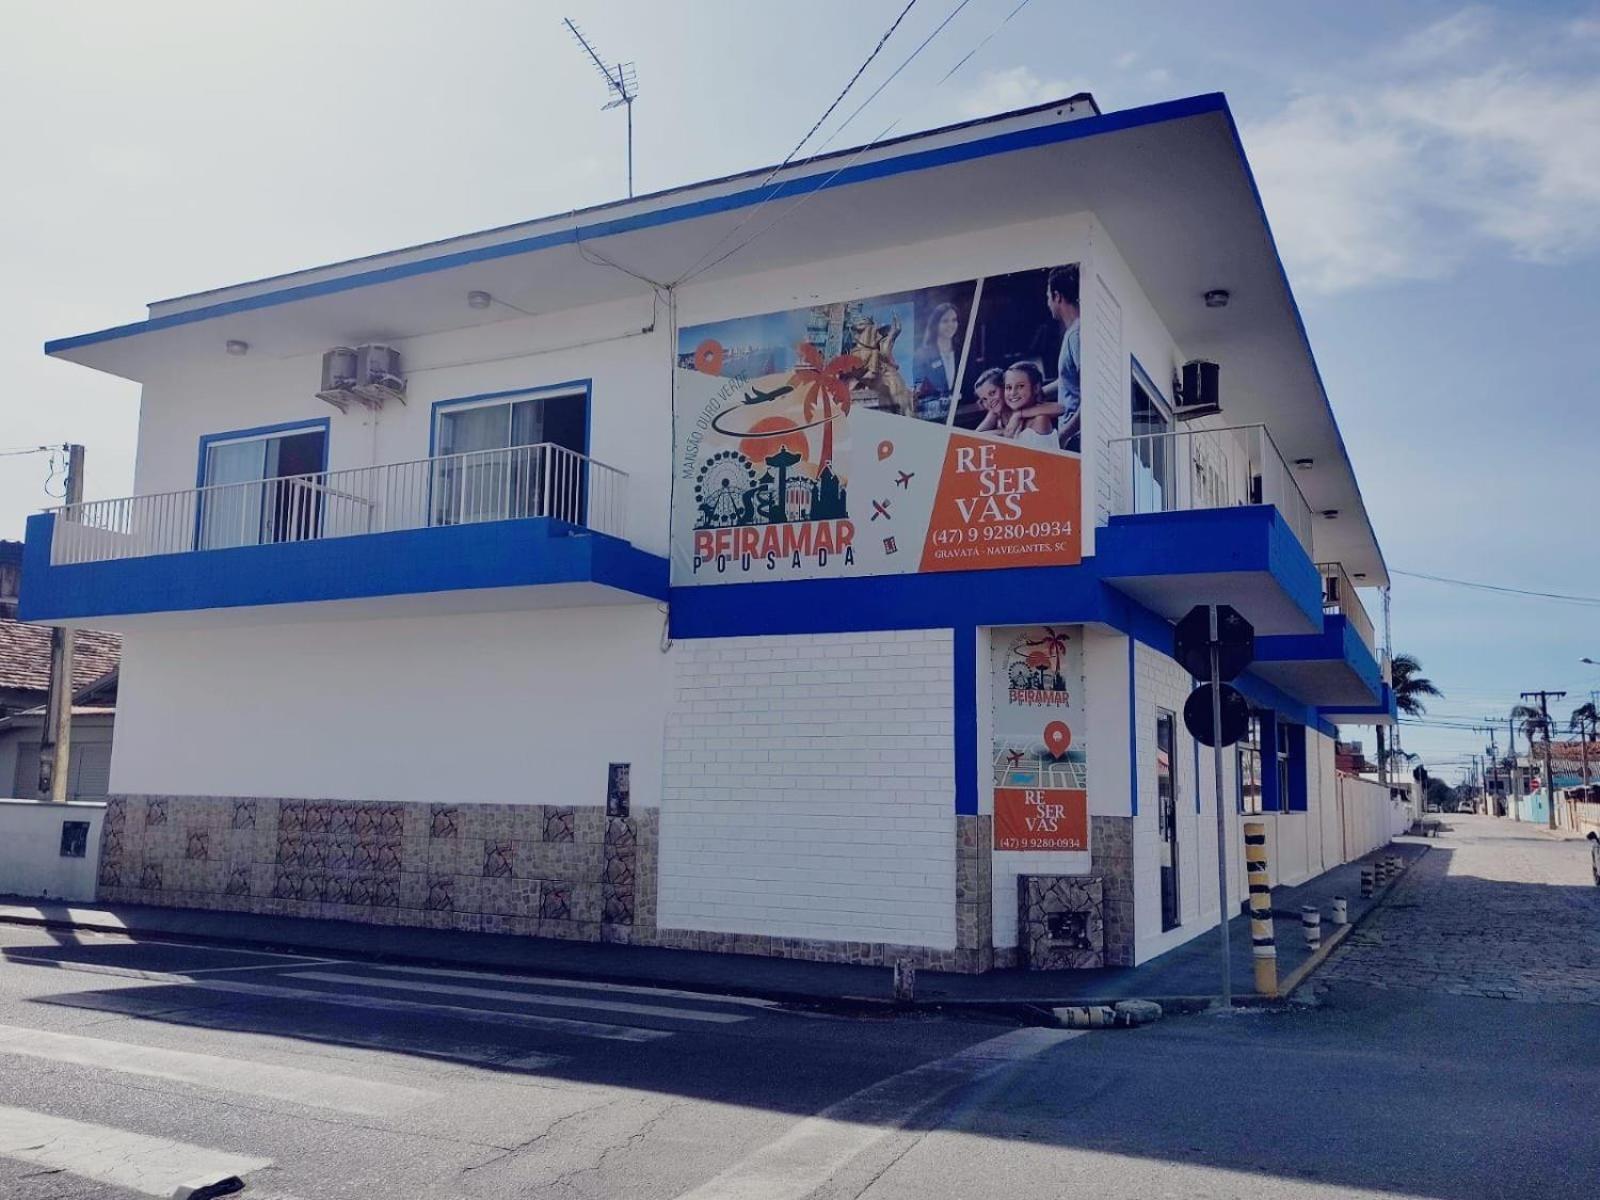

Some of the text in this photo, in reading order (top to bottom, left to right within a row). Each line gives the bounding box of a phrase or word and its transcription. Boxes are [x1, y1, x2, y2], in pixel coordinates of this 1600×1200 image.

[696, 398, 721, 431] OURO
[955, 444, 997, 474] RE
[979, 466, 1040, 497] SER
[955, 493, 1022, 524] VAS
[694, 520, 855, 564] BEIRAMAR
[932, 521, 1072, 545] (47) 9 9280-0934
[1055, 541, 1067, 552] SC
[693, 546, 854, 574] POUSADA
[1009, 690, 1070, 704] BEIRAMAR
[1024, 790, 1046, 805] RE
[1036, 804, 1067, 819] SER
[1024, 817, 1058, 832] VAS
[1000, 838, 1080, 848] (47) 9 9280-0934
